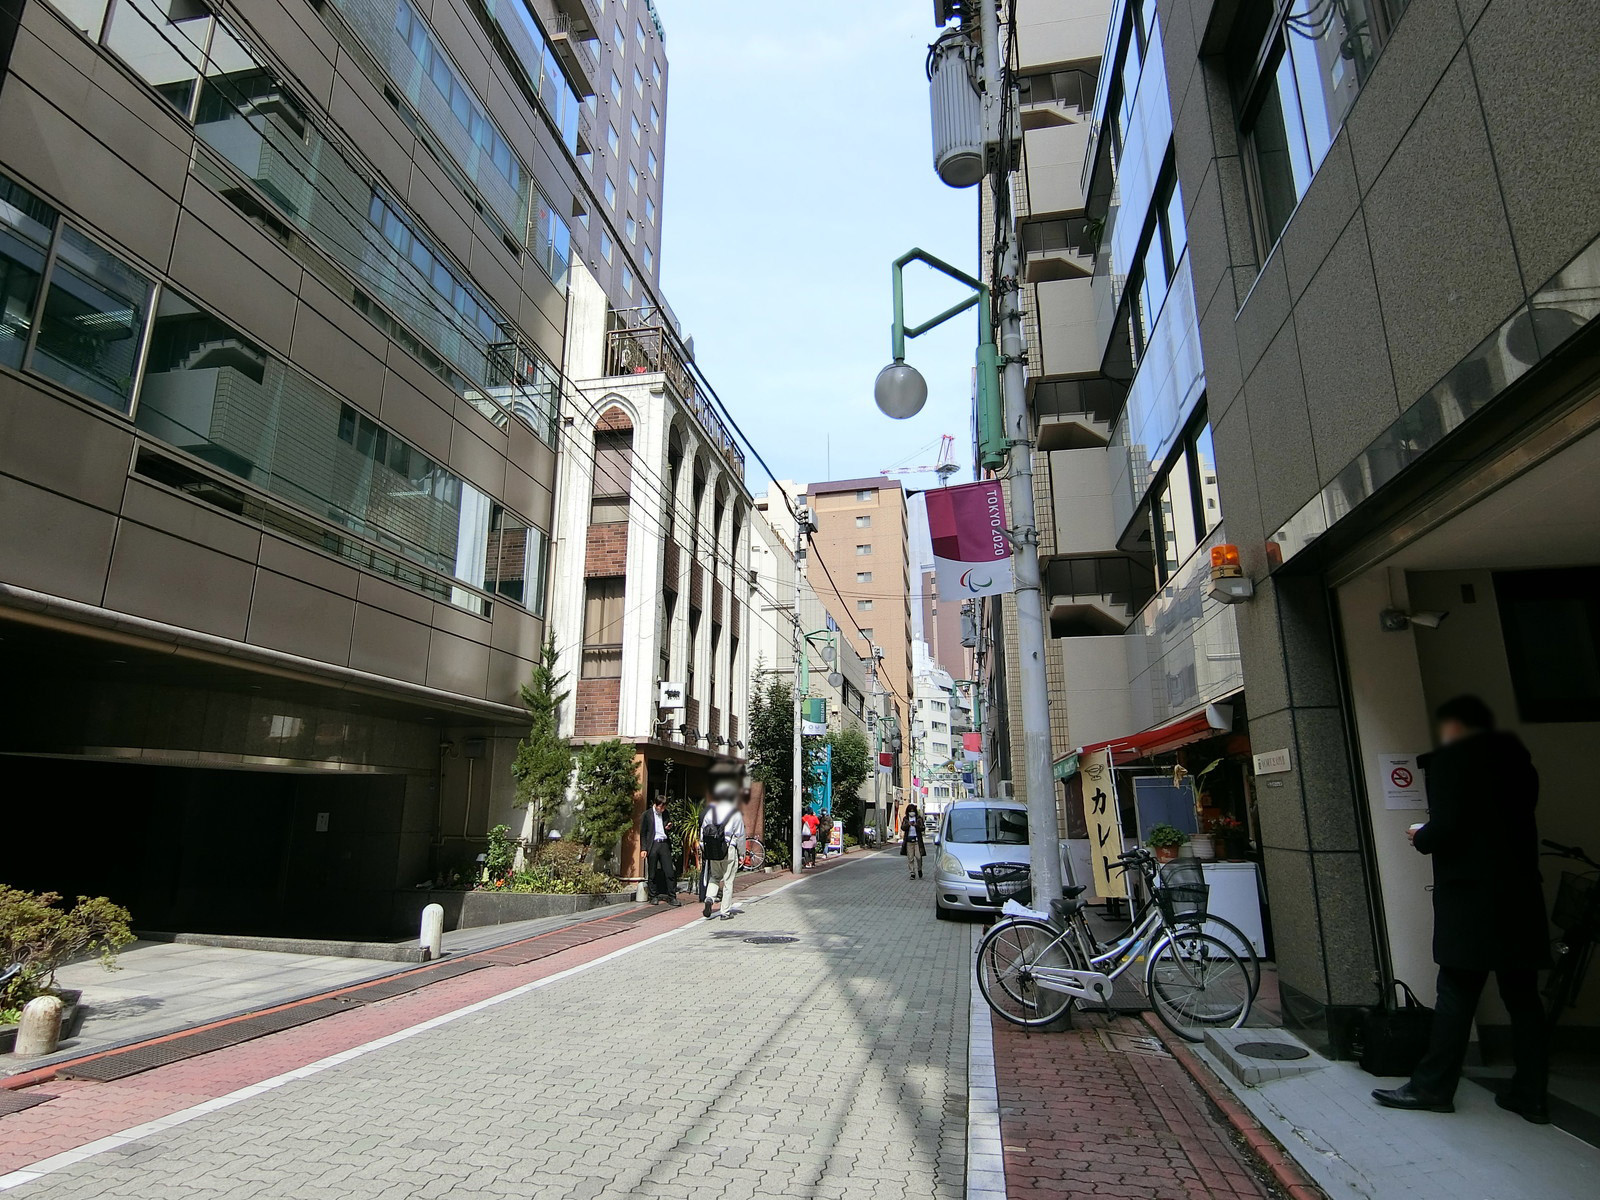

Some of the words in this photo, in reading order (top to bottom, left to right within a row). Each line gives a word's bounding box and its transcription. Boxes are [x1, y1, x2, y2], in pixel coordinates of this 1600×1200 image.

[986, 490, 1001, 527] TOKYO
[991, 529, 1005, 556] 2020
[1091, 787, 1111, 883] カレー
